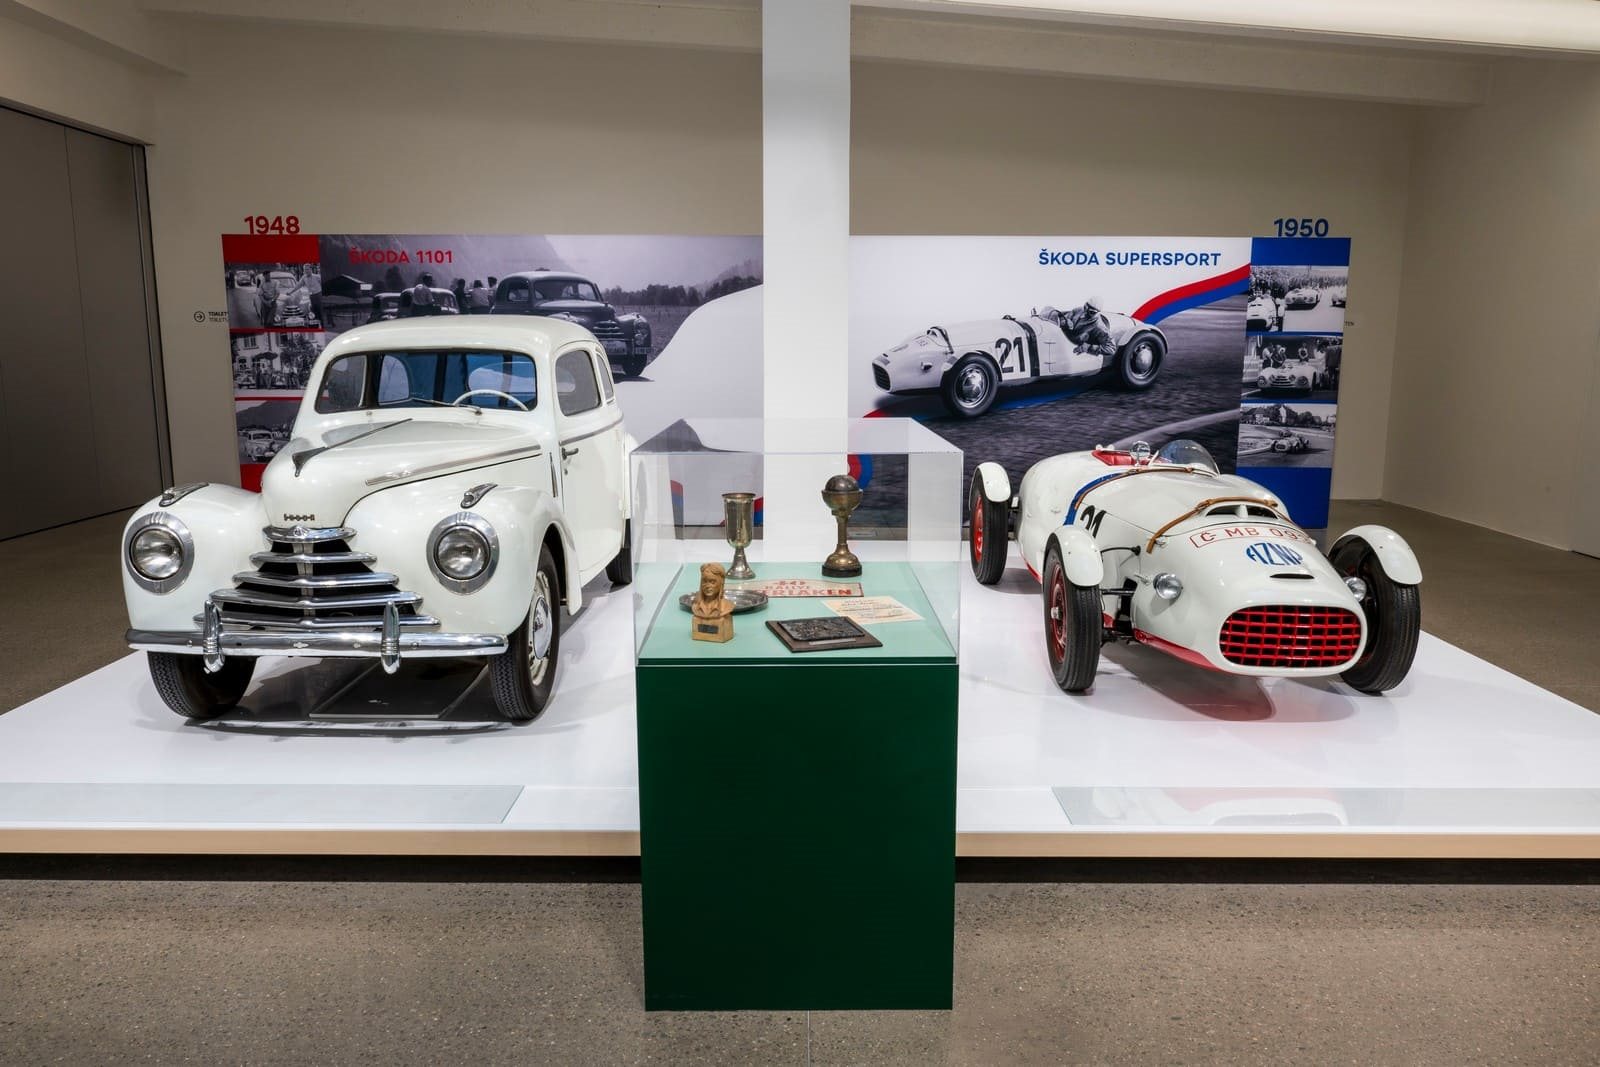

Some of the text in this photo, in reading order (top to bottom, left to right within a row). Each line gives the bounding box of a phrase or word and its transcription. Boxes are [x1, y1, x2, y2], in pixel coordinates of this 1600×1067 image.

[244, 215, 300, 234] 1948
[1273, 218, 1329, 237] 1950
[350, 246, 453, 264] ŠKODA 1101
[1038, 248, 1222, 267] ŠKODA SUPERSPORT
[995, 337, 1026, 374] 21
[1224, 526, 1260, 538] MB
